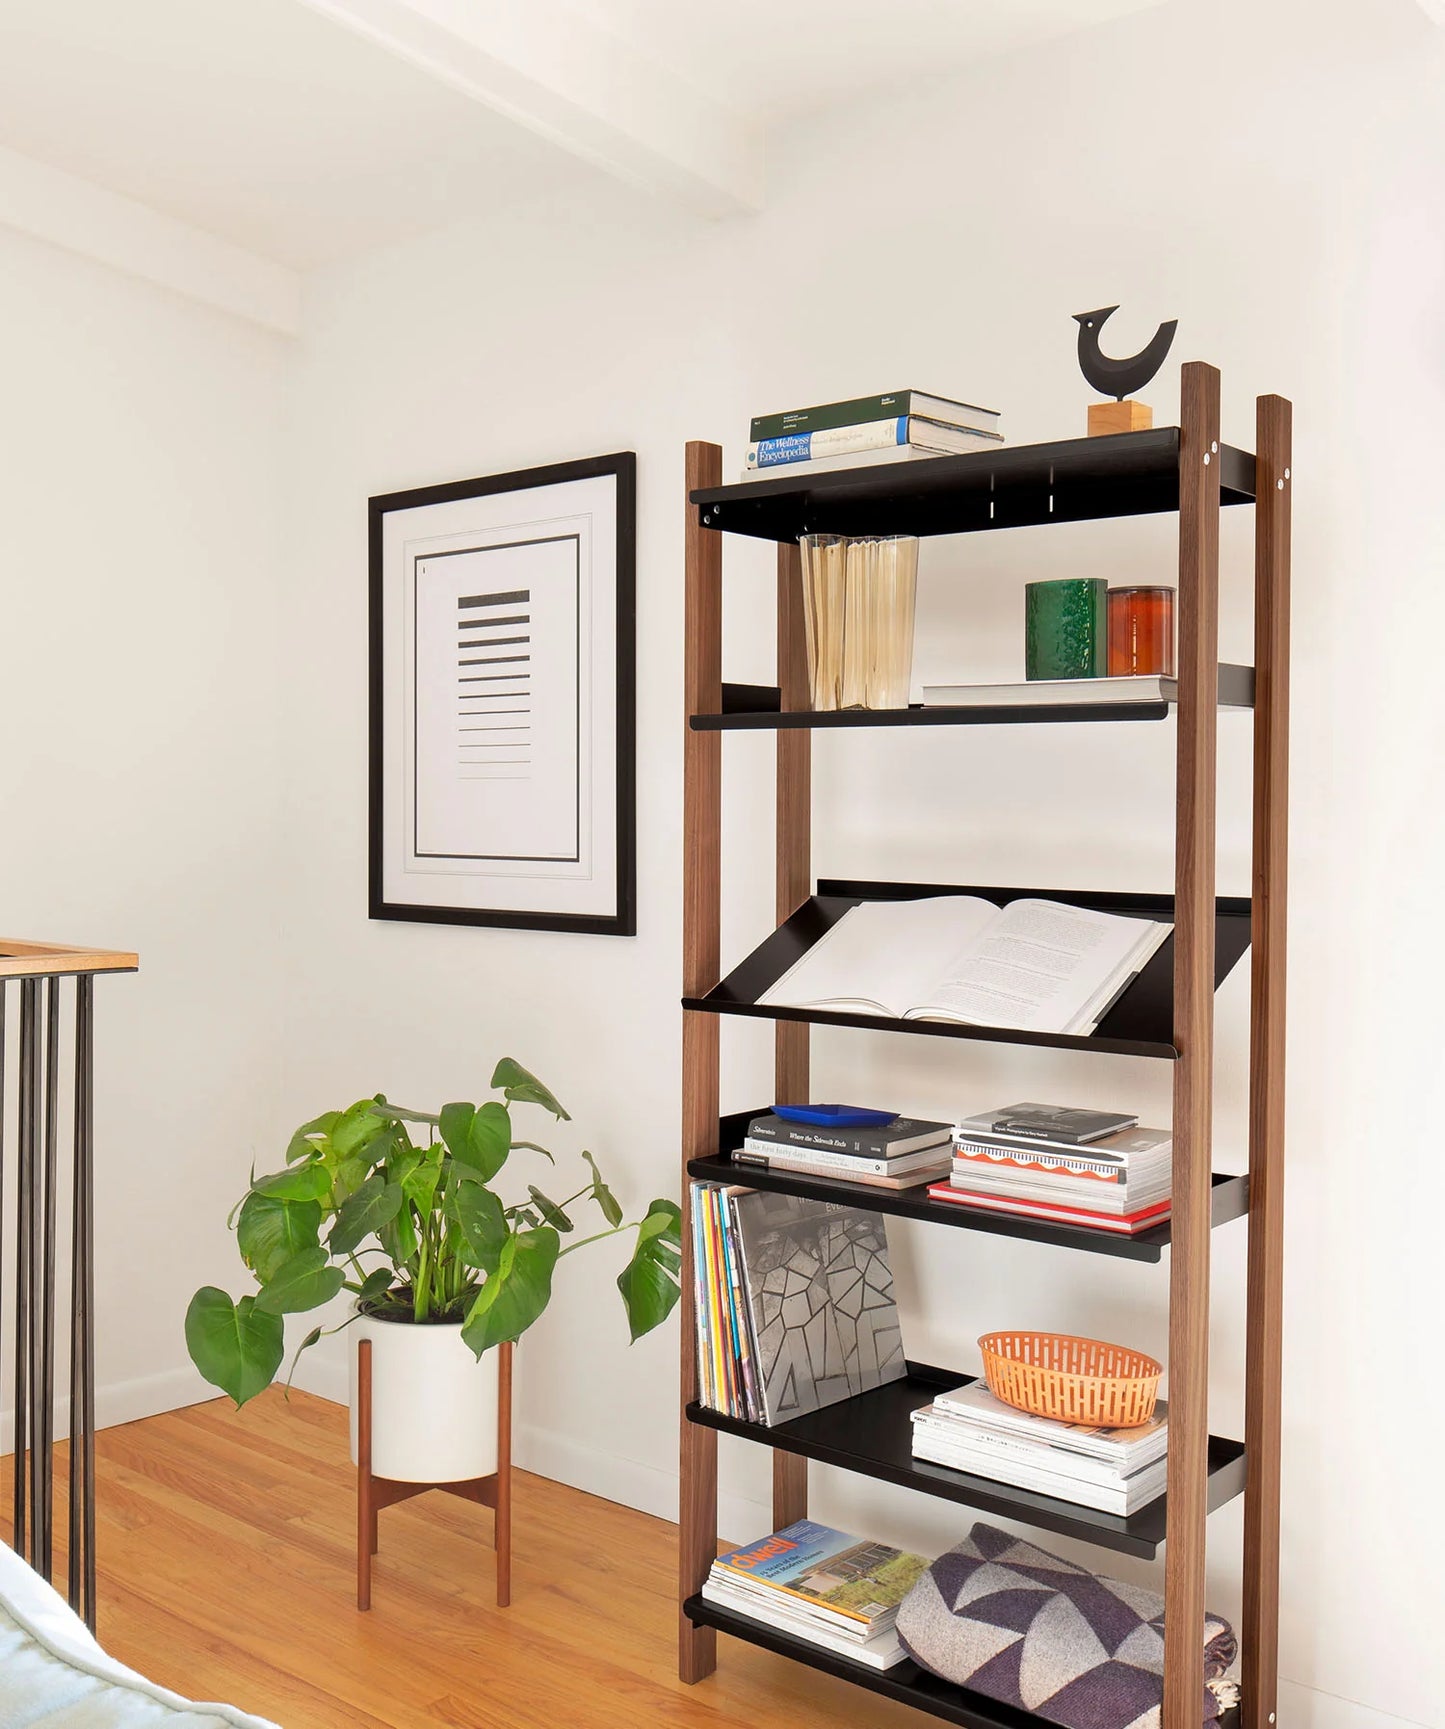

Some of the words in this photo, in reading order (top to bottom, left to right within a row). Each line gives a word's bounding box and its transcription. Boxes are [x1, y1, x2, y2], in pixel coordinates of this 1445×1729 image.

[760, 441, 775, 451] The
[776, 436, 810, 448] Wellness
[759, 445, 809, 462] Encyclopedia
[812, 1135, 833, 1146] Sidewalk
[731, 1537, 799, 1569] dwell
